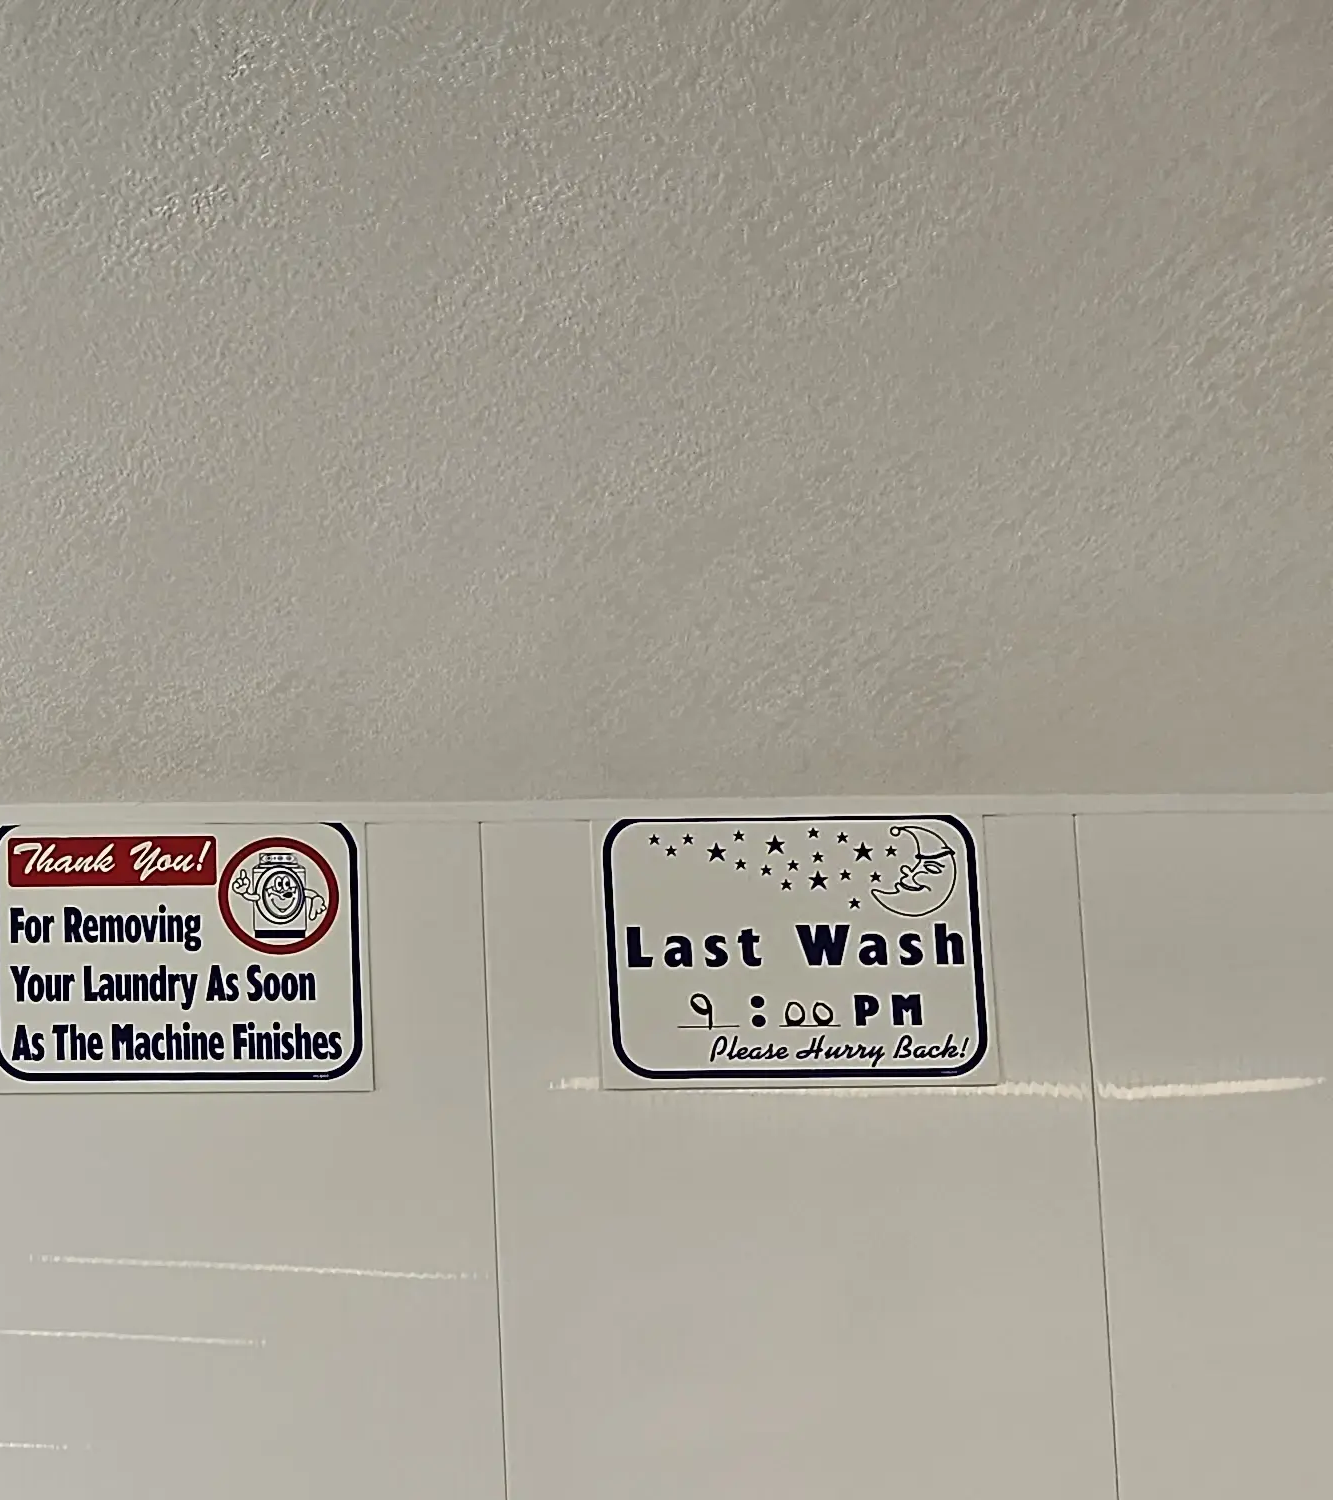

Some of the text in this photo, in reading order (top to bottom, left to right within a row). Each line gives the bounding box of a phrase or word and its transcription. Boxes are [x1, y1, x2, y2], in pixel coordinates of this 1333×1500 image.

[14, 841, 211, 883] Thank You!
[10, 905, 201, 952] For Removing
[626, 923, 965, 968] Last Wash
[10, 965, 316, 1010] Your Laundry As Soon
[12, 1022, 342, 1061] As The Machine Finishes
[710, 1034, 969, 1067] Please Hurry Back!
